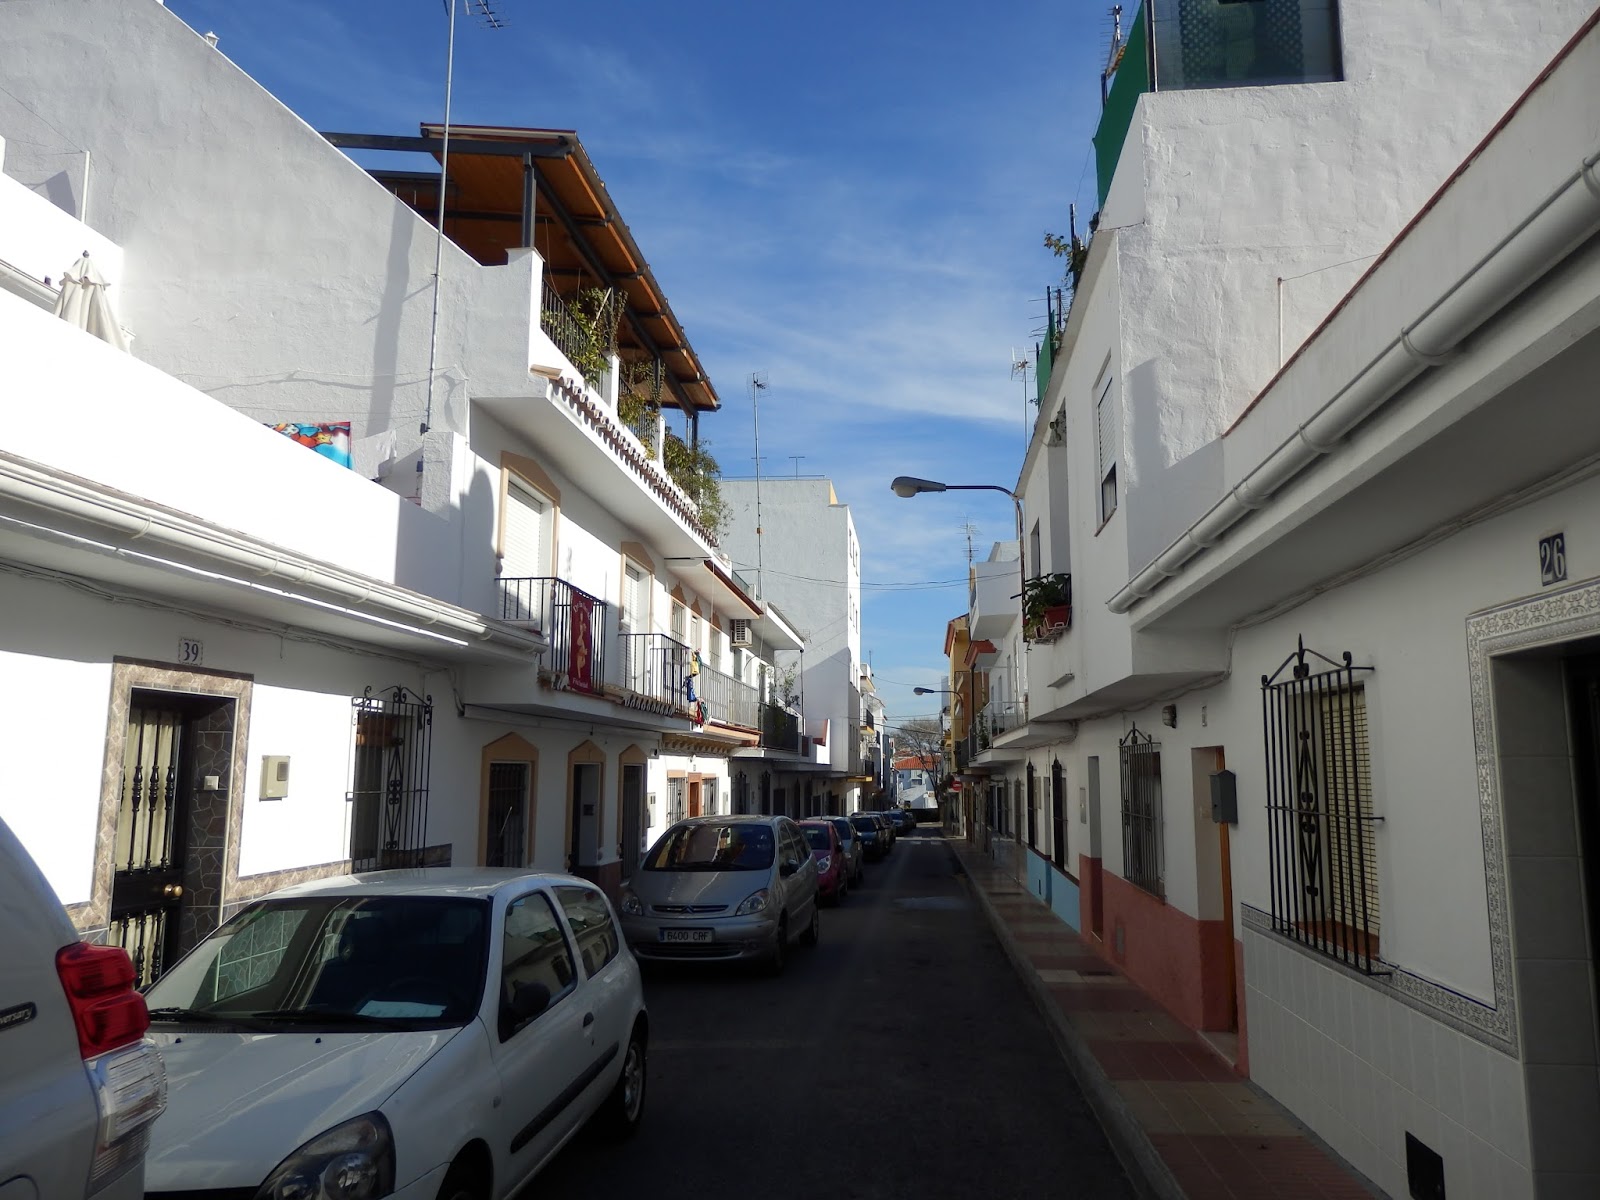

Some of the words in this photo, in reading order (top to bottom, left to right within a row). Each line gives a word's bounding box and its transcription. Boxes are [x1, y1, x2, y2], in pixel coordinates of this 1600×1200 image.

[1541, 538, 1565, 582] 26
[183, 642, 199, 662] 39
[692, 931, 709, 941] CRF
